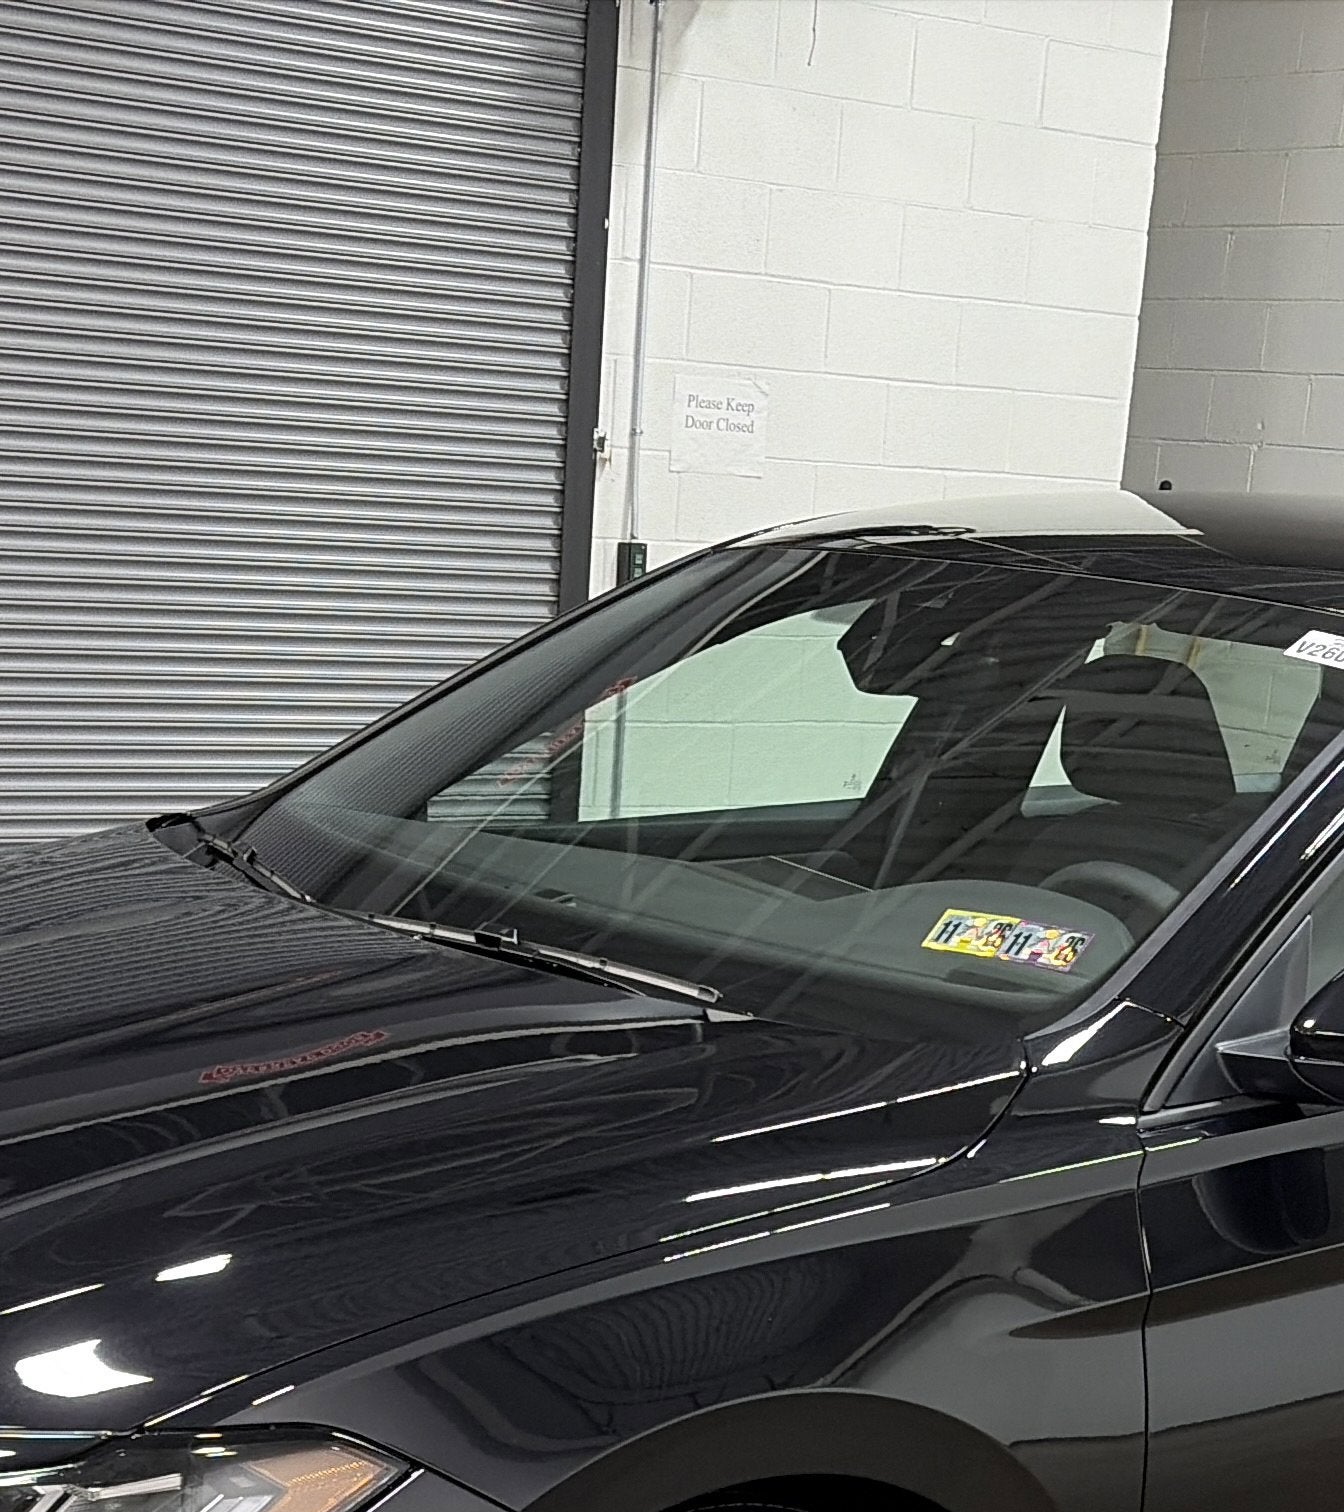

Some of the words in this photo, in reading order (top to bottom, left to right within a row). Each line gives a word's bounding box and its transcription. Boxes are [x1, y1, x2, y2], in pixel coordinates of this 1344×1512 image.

[687, 394, 723, 411] Please
[726, 397, 755, 417] Keep
[684, 414, 714, 430] Door
[716, 417, 755, 434] Closed
[935, 920, 963, 944] 11
[1005, 931, 1033, 956] 11
